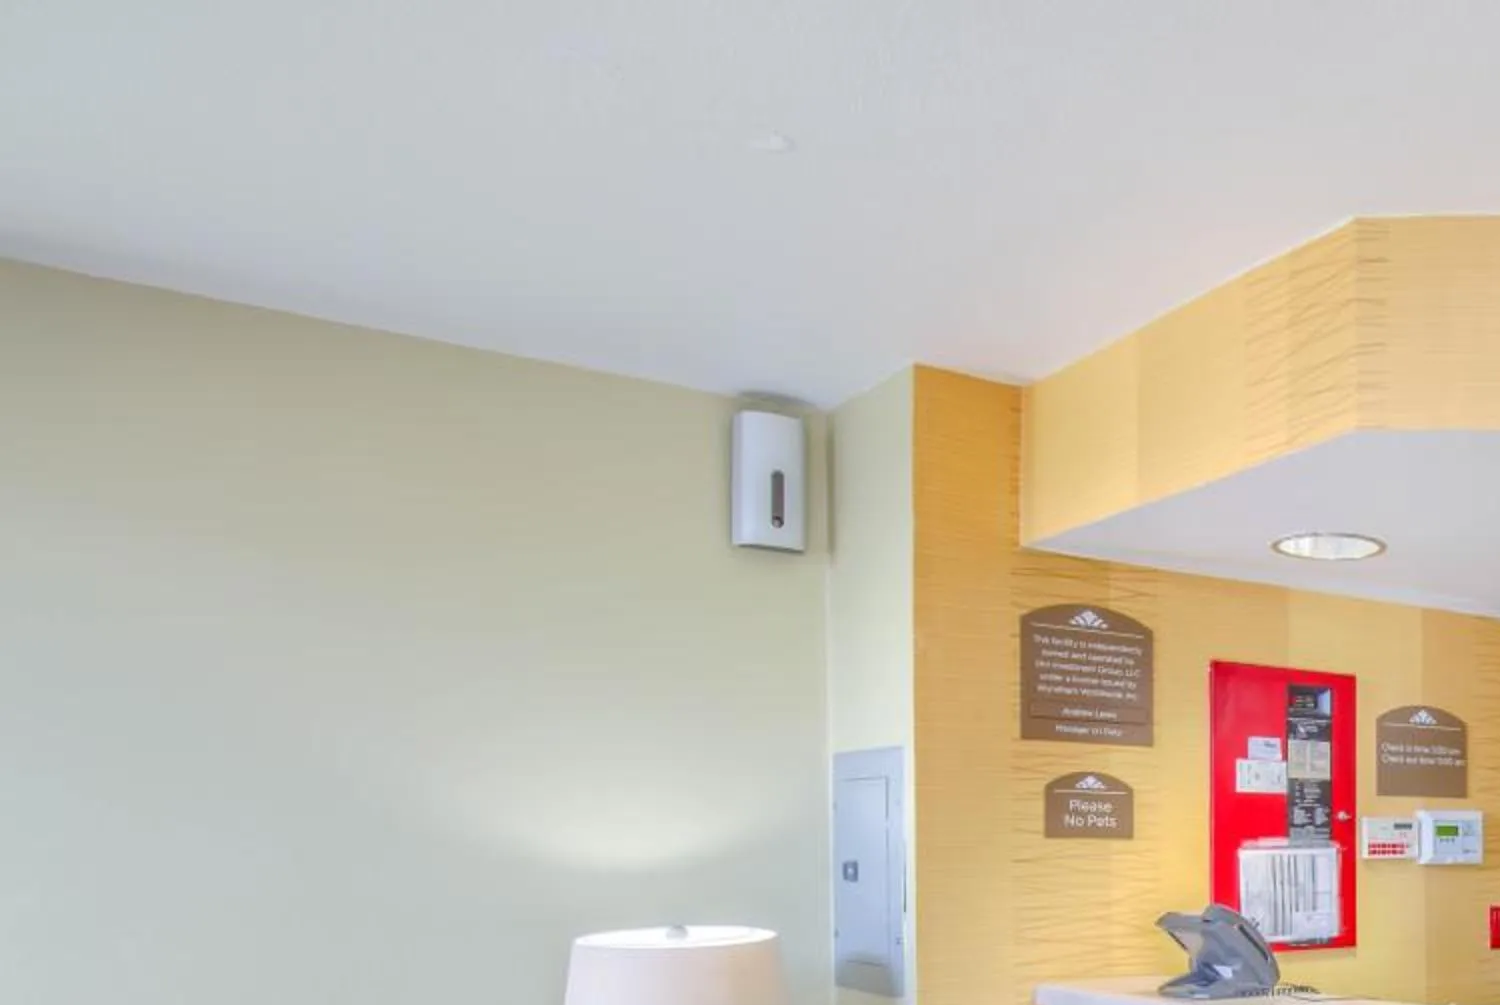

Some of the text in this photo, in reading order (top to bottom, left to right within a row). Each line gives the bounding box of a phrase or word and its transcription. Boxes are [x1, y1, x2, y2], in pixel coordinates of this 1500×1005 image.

[1069, 799, 1113, 813] Please
[1064, 814, 1118, 828] No Pets
